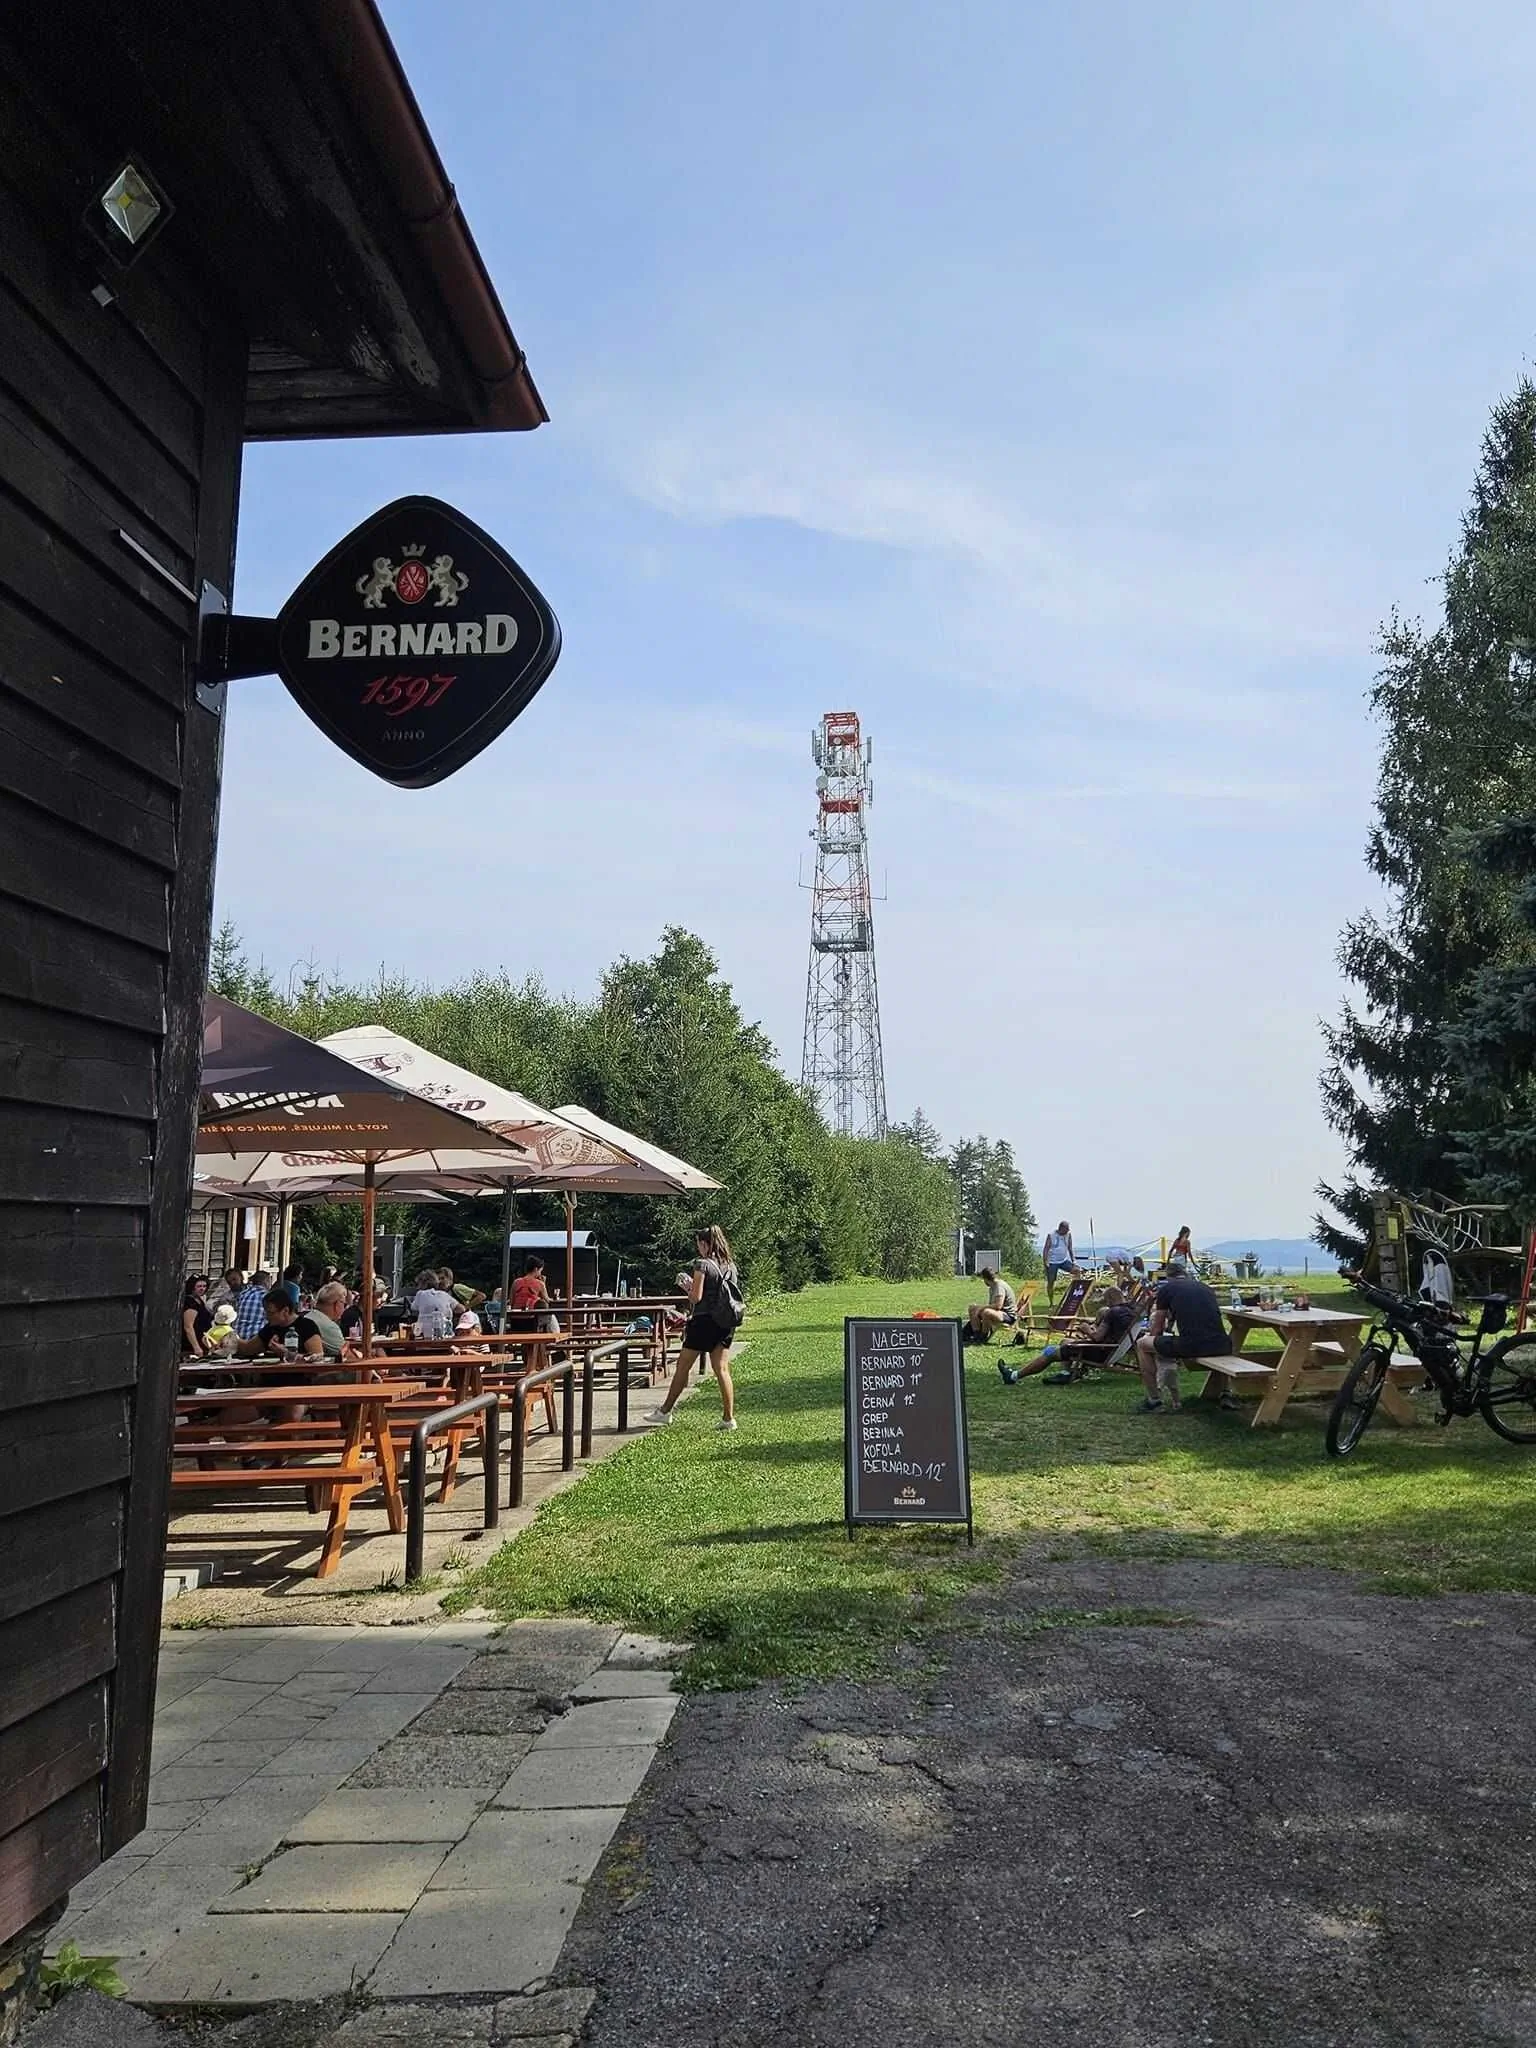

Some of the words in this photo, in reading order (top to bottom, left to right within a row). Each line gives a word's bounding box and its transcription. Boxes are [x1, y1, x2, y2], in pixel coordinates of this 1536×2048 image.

[307, 614, 519, 659] BERNARD
[360, 673, 457, 717] 1597
[381, 730, 426, 741] ANNO
[872, 1331, 888, 1348] NA
[890, 1328, 923, 1347] ČEPU
[861, 1355, 906, 1370] BERNARD
[862, 1373, 905, 1391] BERNARD
[862, 1392, 895, 1409] ČERNÁ
[862, 1412, 889, 1425] GREP
[863, 1443, 901, 1459] KOFOLA
[862, 1459, 922, 1477] BERNARD
[893, 1497, 926, 1505] BERNARD
